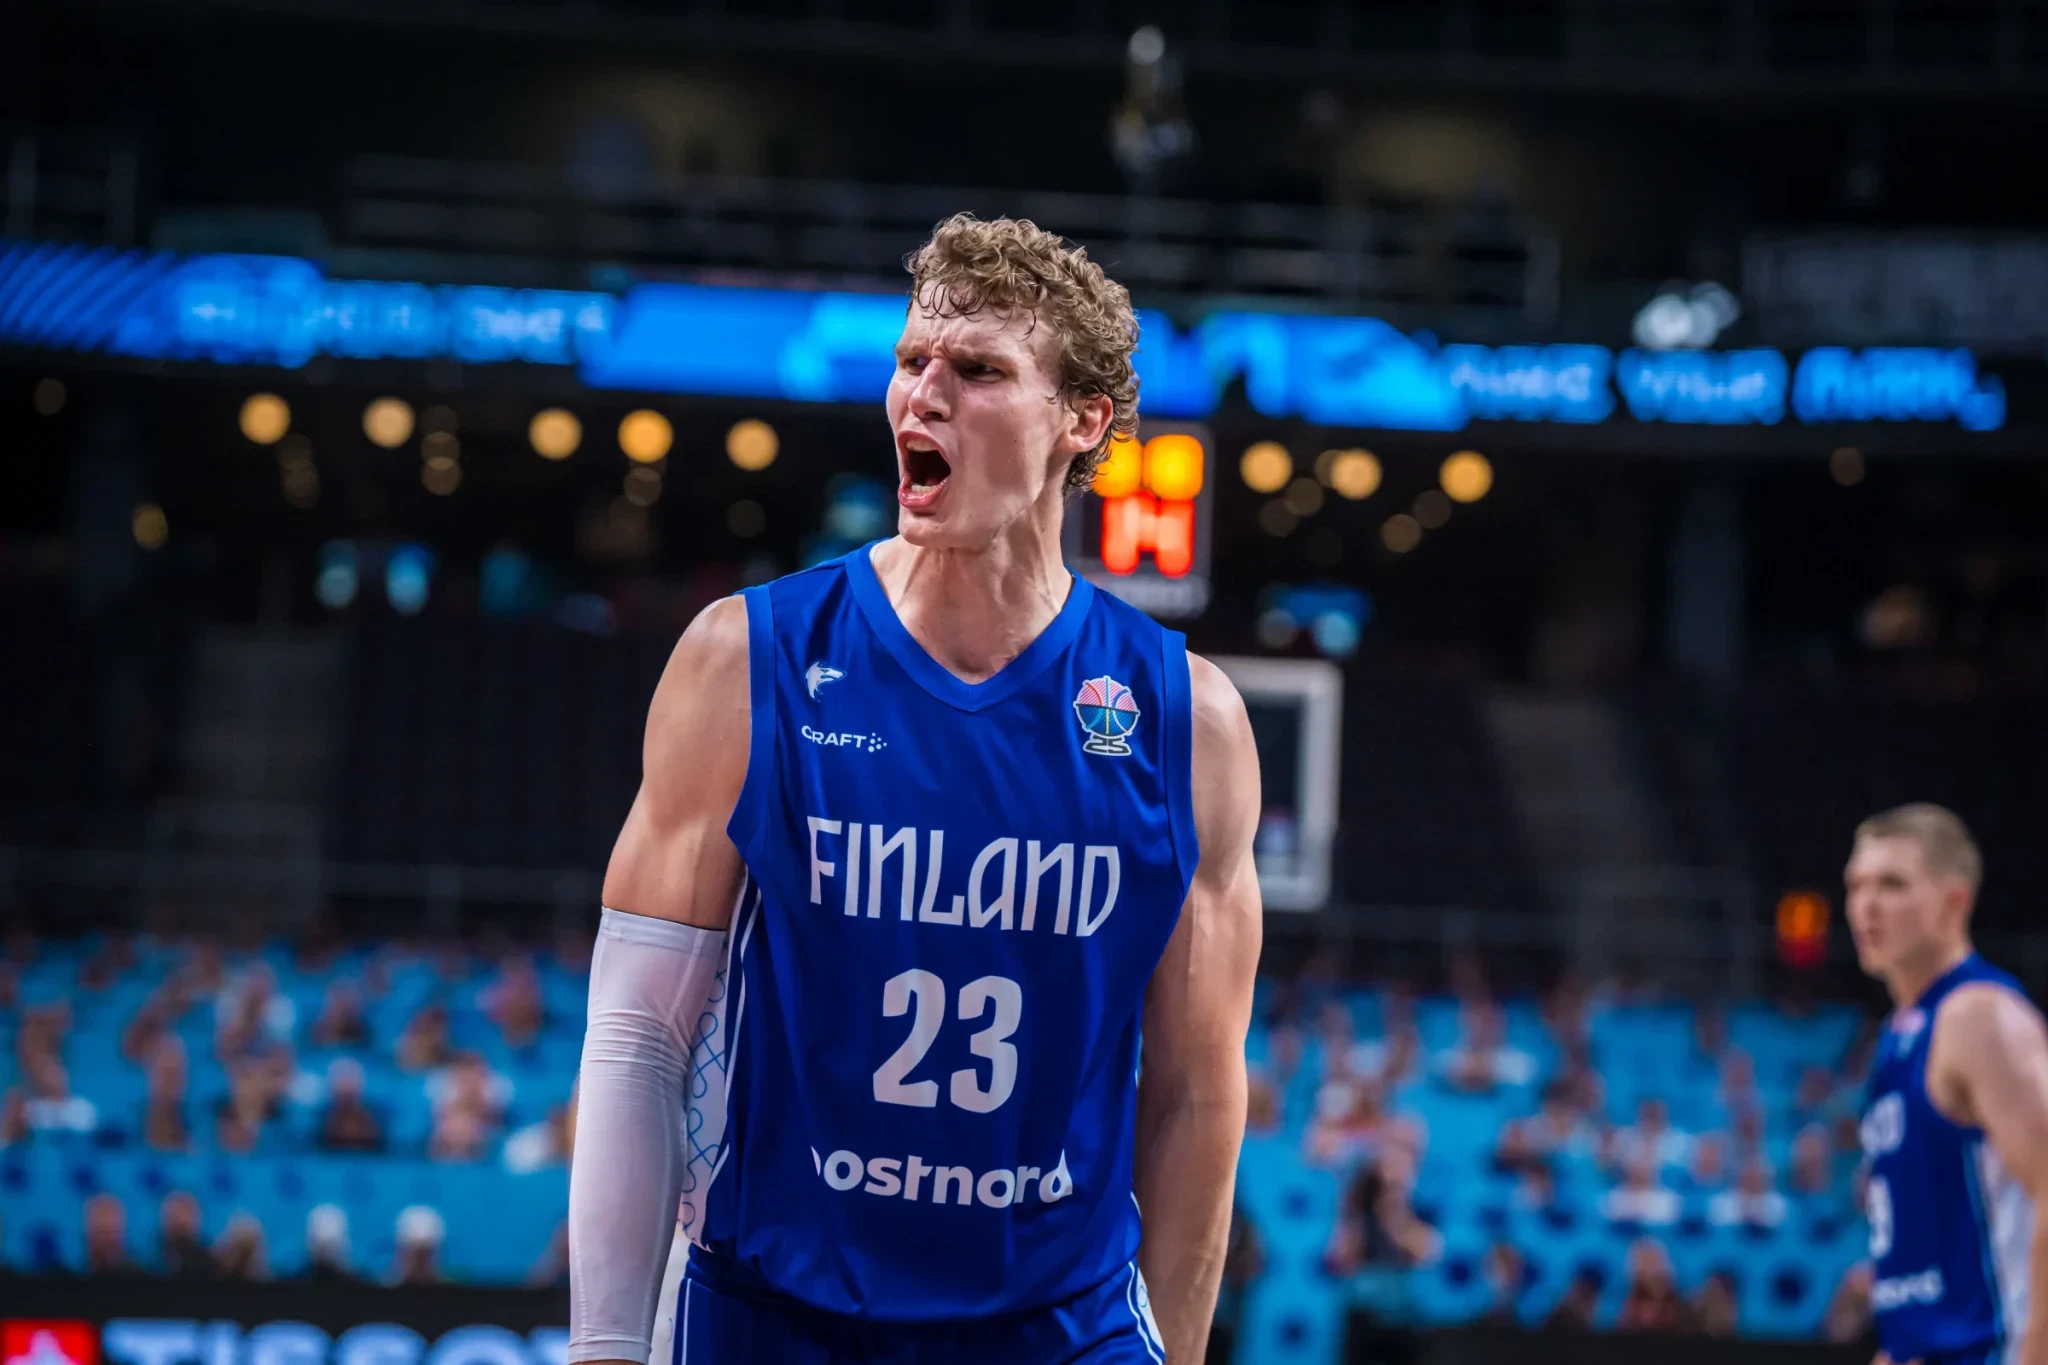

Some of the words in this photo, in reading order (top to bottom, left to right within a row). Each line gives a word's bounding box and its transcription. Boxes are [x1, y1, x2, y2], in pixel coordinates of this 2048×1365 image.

[801, 726, 867, 750] CRAFT
[807, 816, 1121, 937] FINLAND
[873, 968, 1022, 1113] 23
[811, 1146, 1073, 1208] ostnord
